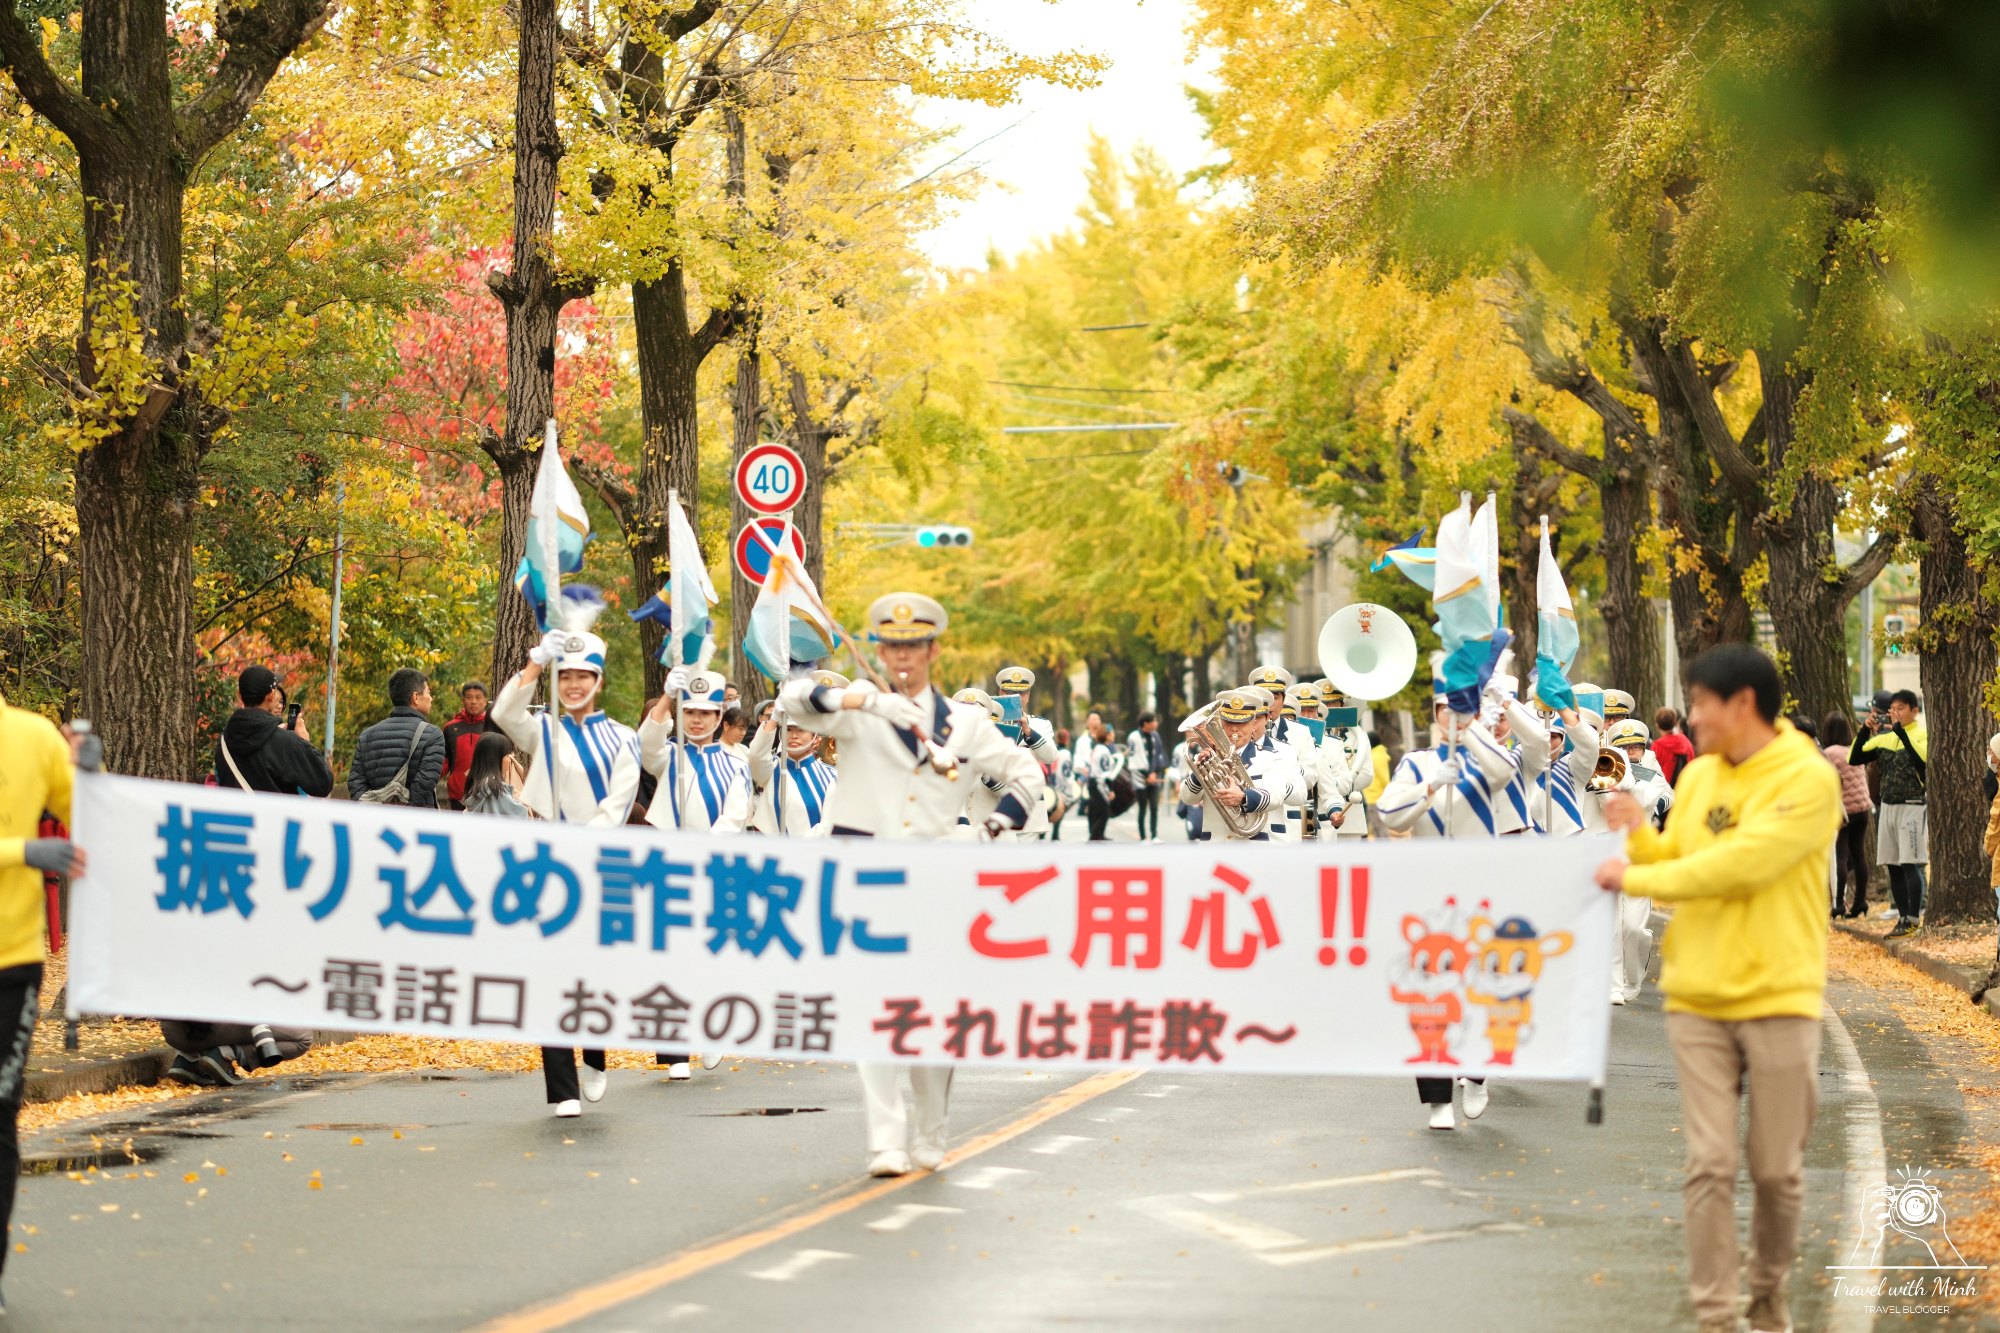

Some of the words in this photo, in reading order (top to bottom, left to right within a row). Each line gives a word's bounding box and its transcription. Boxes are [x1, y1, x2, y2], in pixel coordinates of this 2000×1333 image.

[752, 464, 790, 494] 40
[155, 802, 909, 960] 振り込め詐欺に
[559, 979, 836, 1052] お金の話
